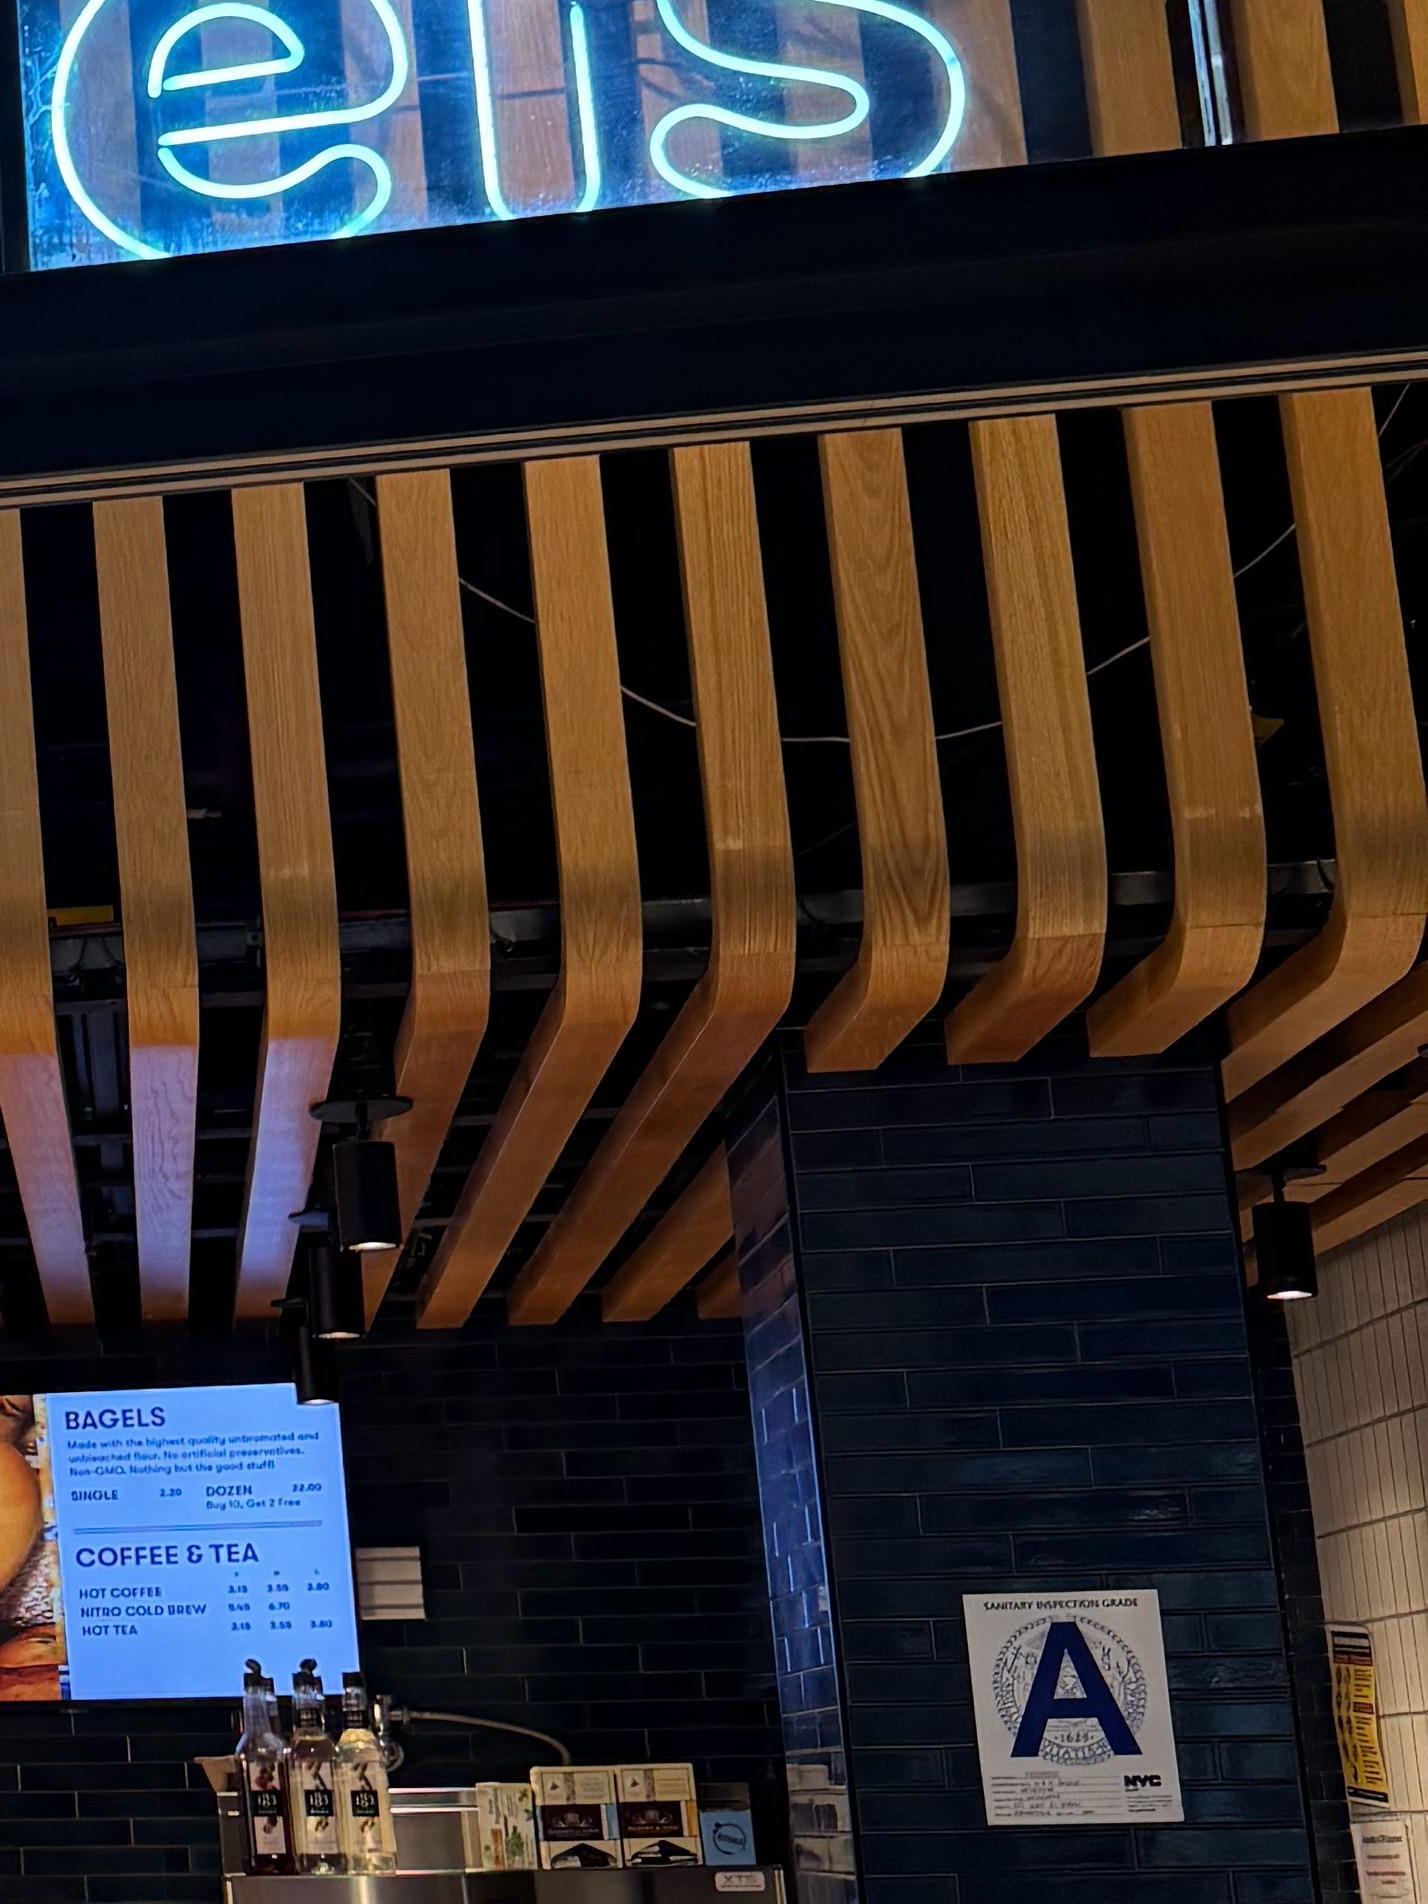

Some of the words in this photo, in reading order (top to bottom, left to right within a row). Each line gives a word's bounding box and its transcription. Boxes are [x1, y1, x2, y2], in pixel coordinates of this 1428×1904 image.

[65, 1407, 166, 1430] BAGELS
[100, 1439, 122, 1447] with
[126, 1438, 142, 1446] the
[146, 1436, 185, 1447] highest
[188, 1434, 225, 1446] quality
[298, 1431, 318, 1441] and
[181, 1448, 226, 1458] artificial
[130, 1463, 171, 1475] Nothing
[175, 1463, 192, 1473] but
[196, 1462, 213, 1471] the
[216, 1462, 243, 1473] good
[72, 1490, 118, 1501] SINGLE
[206, 1485, 252, 1496] DOZEN
[206, 1500, 226, 1510] Buy
[246, 1498, 266, 1508] Get
[269, 1498, 276, 1506] 2
[279, 1498, 301, 1506] Free
[75, 1546, 179, 1567] COFFEE
[186, 1545, 203, 1564] &
[209, 1543, 259, 1563] TEA
[79, 1588, 105, 1599] HOT
[111, 1587, 162, 1598] COFFEE
[984, 1600, 1033, 1610] SANITARY
[1036, 1600, 1099, 1609] INSPECTION
[1102, 1597, 1138, 1608] GRADE
[81, 1606, 121, 1617] NITRO
[126, 1606, 164, 1616] COLD
[168, 1604, 206, 1615] BREW
[82, 1625, 109, 1636] HOT
[115, 1624, 138, 1635] TEA
[1011, 1622, 1142, 1757] A
[1124, 1774, 1161, 1787] NYC
